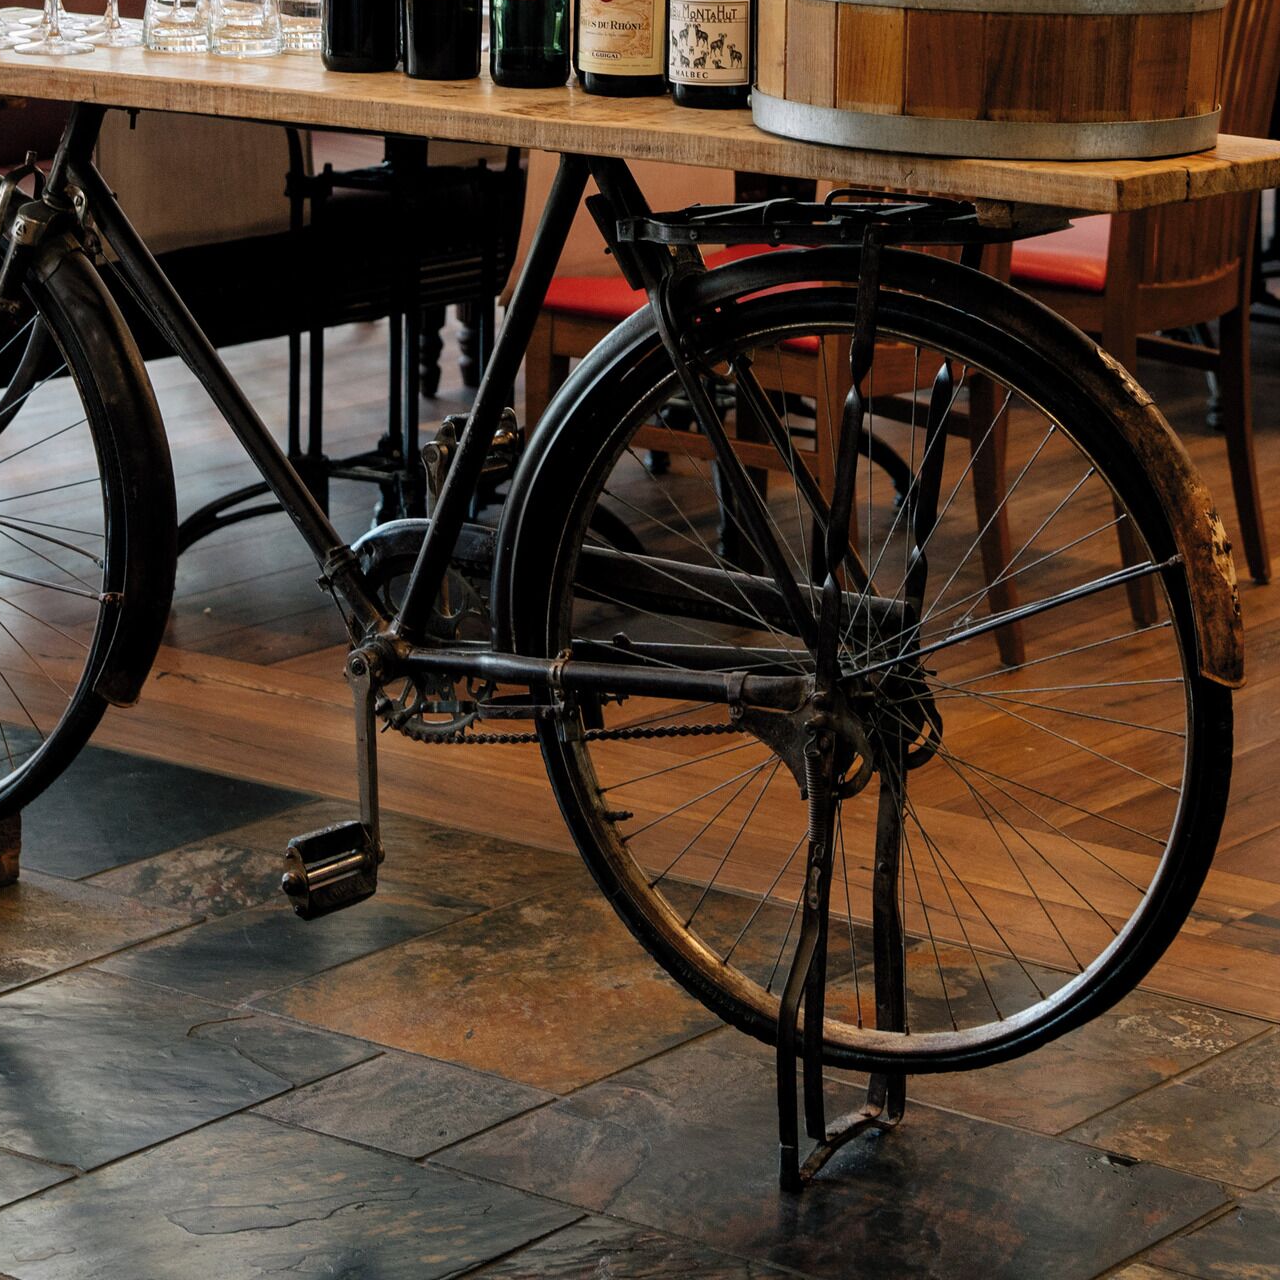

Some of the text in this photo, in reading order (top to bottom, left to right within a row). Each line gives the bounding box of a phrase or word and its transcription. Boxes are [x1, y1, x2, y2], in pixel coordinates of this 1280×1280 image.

[598, 21, 609, 29] DU
[611, 20, 644, 31] RHÔNE
[675, 70, 709, 79] MALBEC
